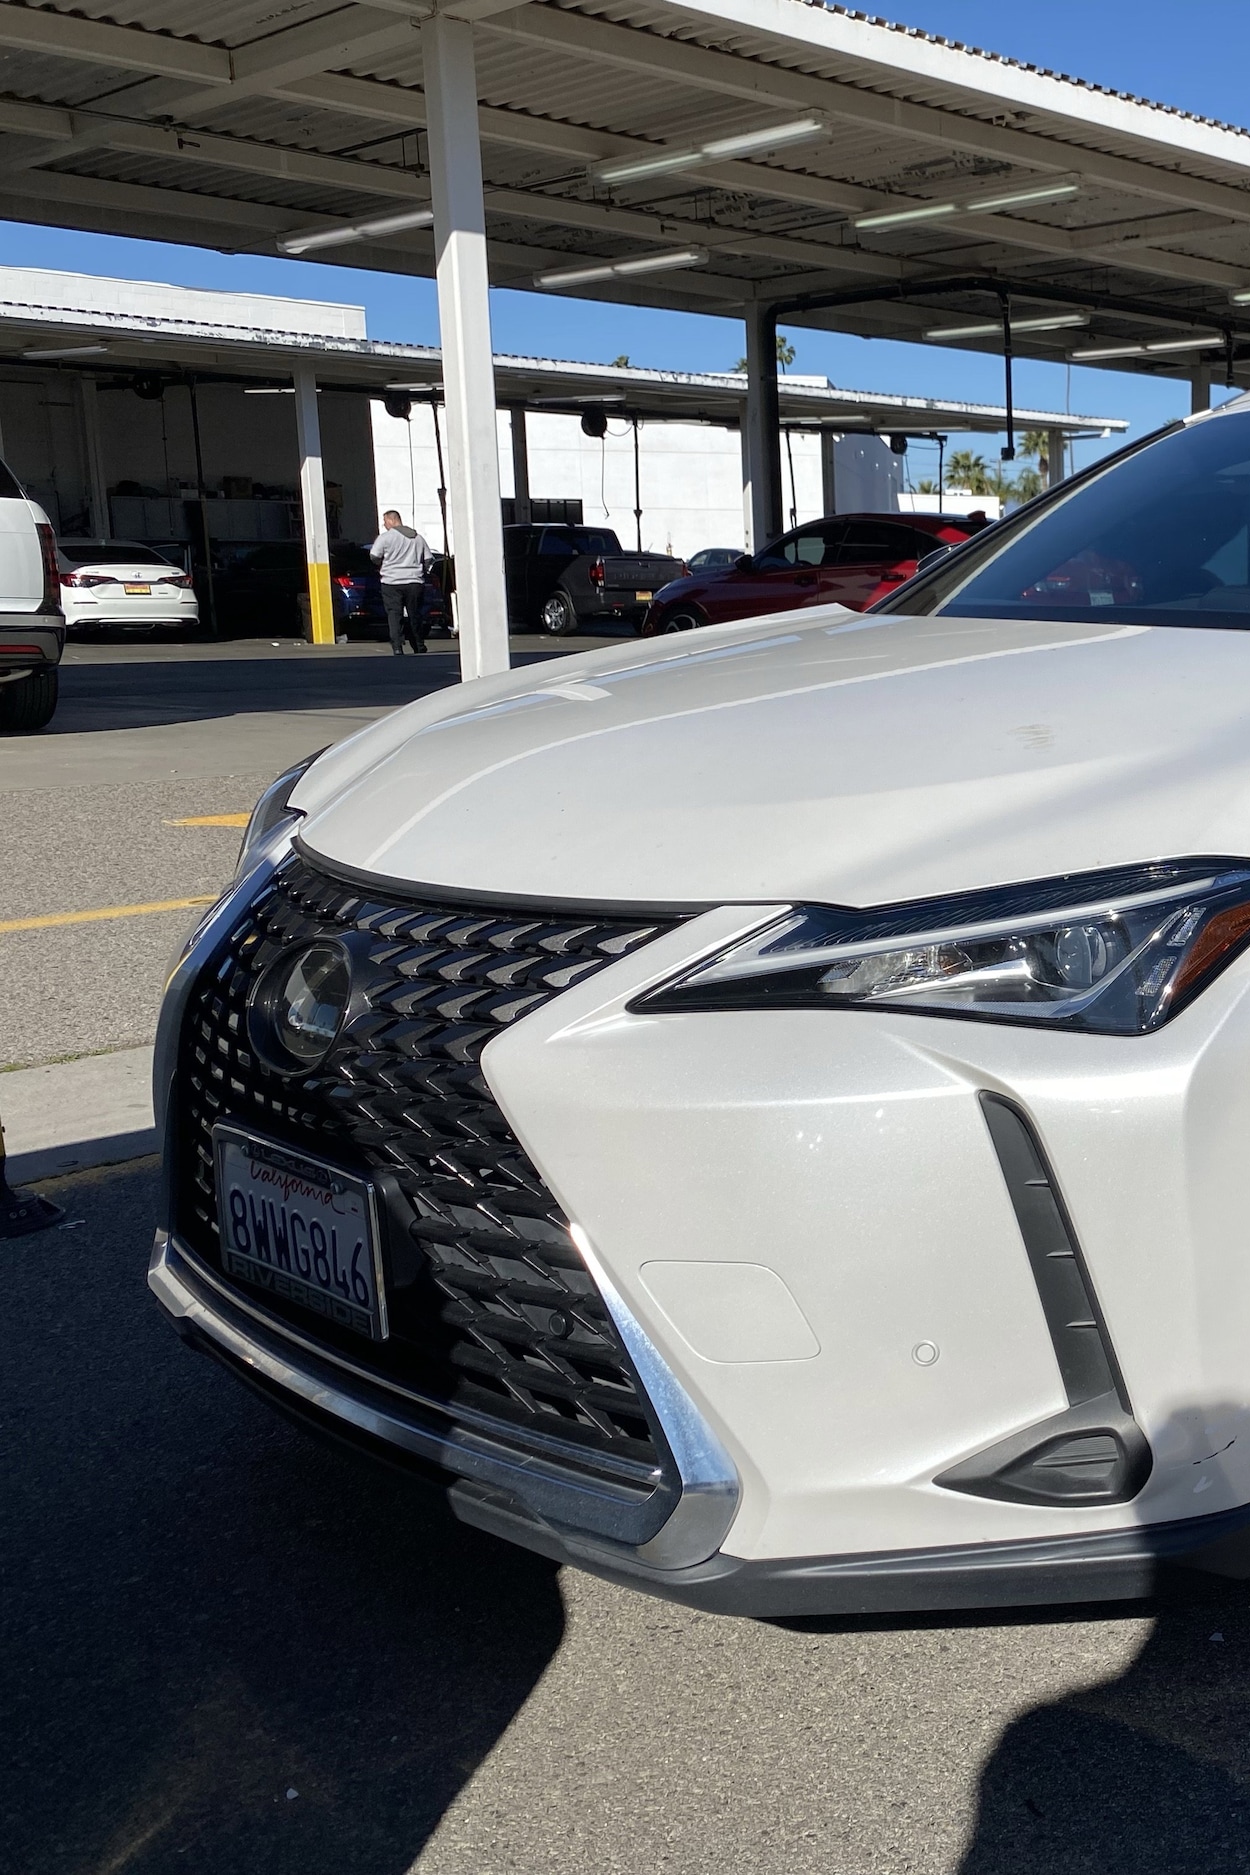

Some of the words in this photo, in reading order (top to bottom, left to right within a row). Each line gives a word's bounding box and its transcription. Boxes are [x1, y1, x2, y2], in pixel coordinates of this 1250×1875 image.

[250, 1160, 345, 1216] California
[262, 1148, 318, 1179] LEXUS
[229, 1188, 370, 1309] 8WWG846
[231, 1254, 370, 1336] RIVERSIDE
